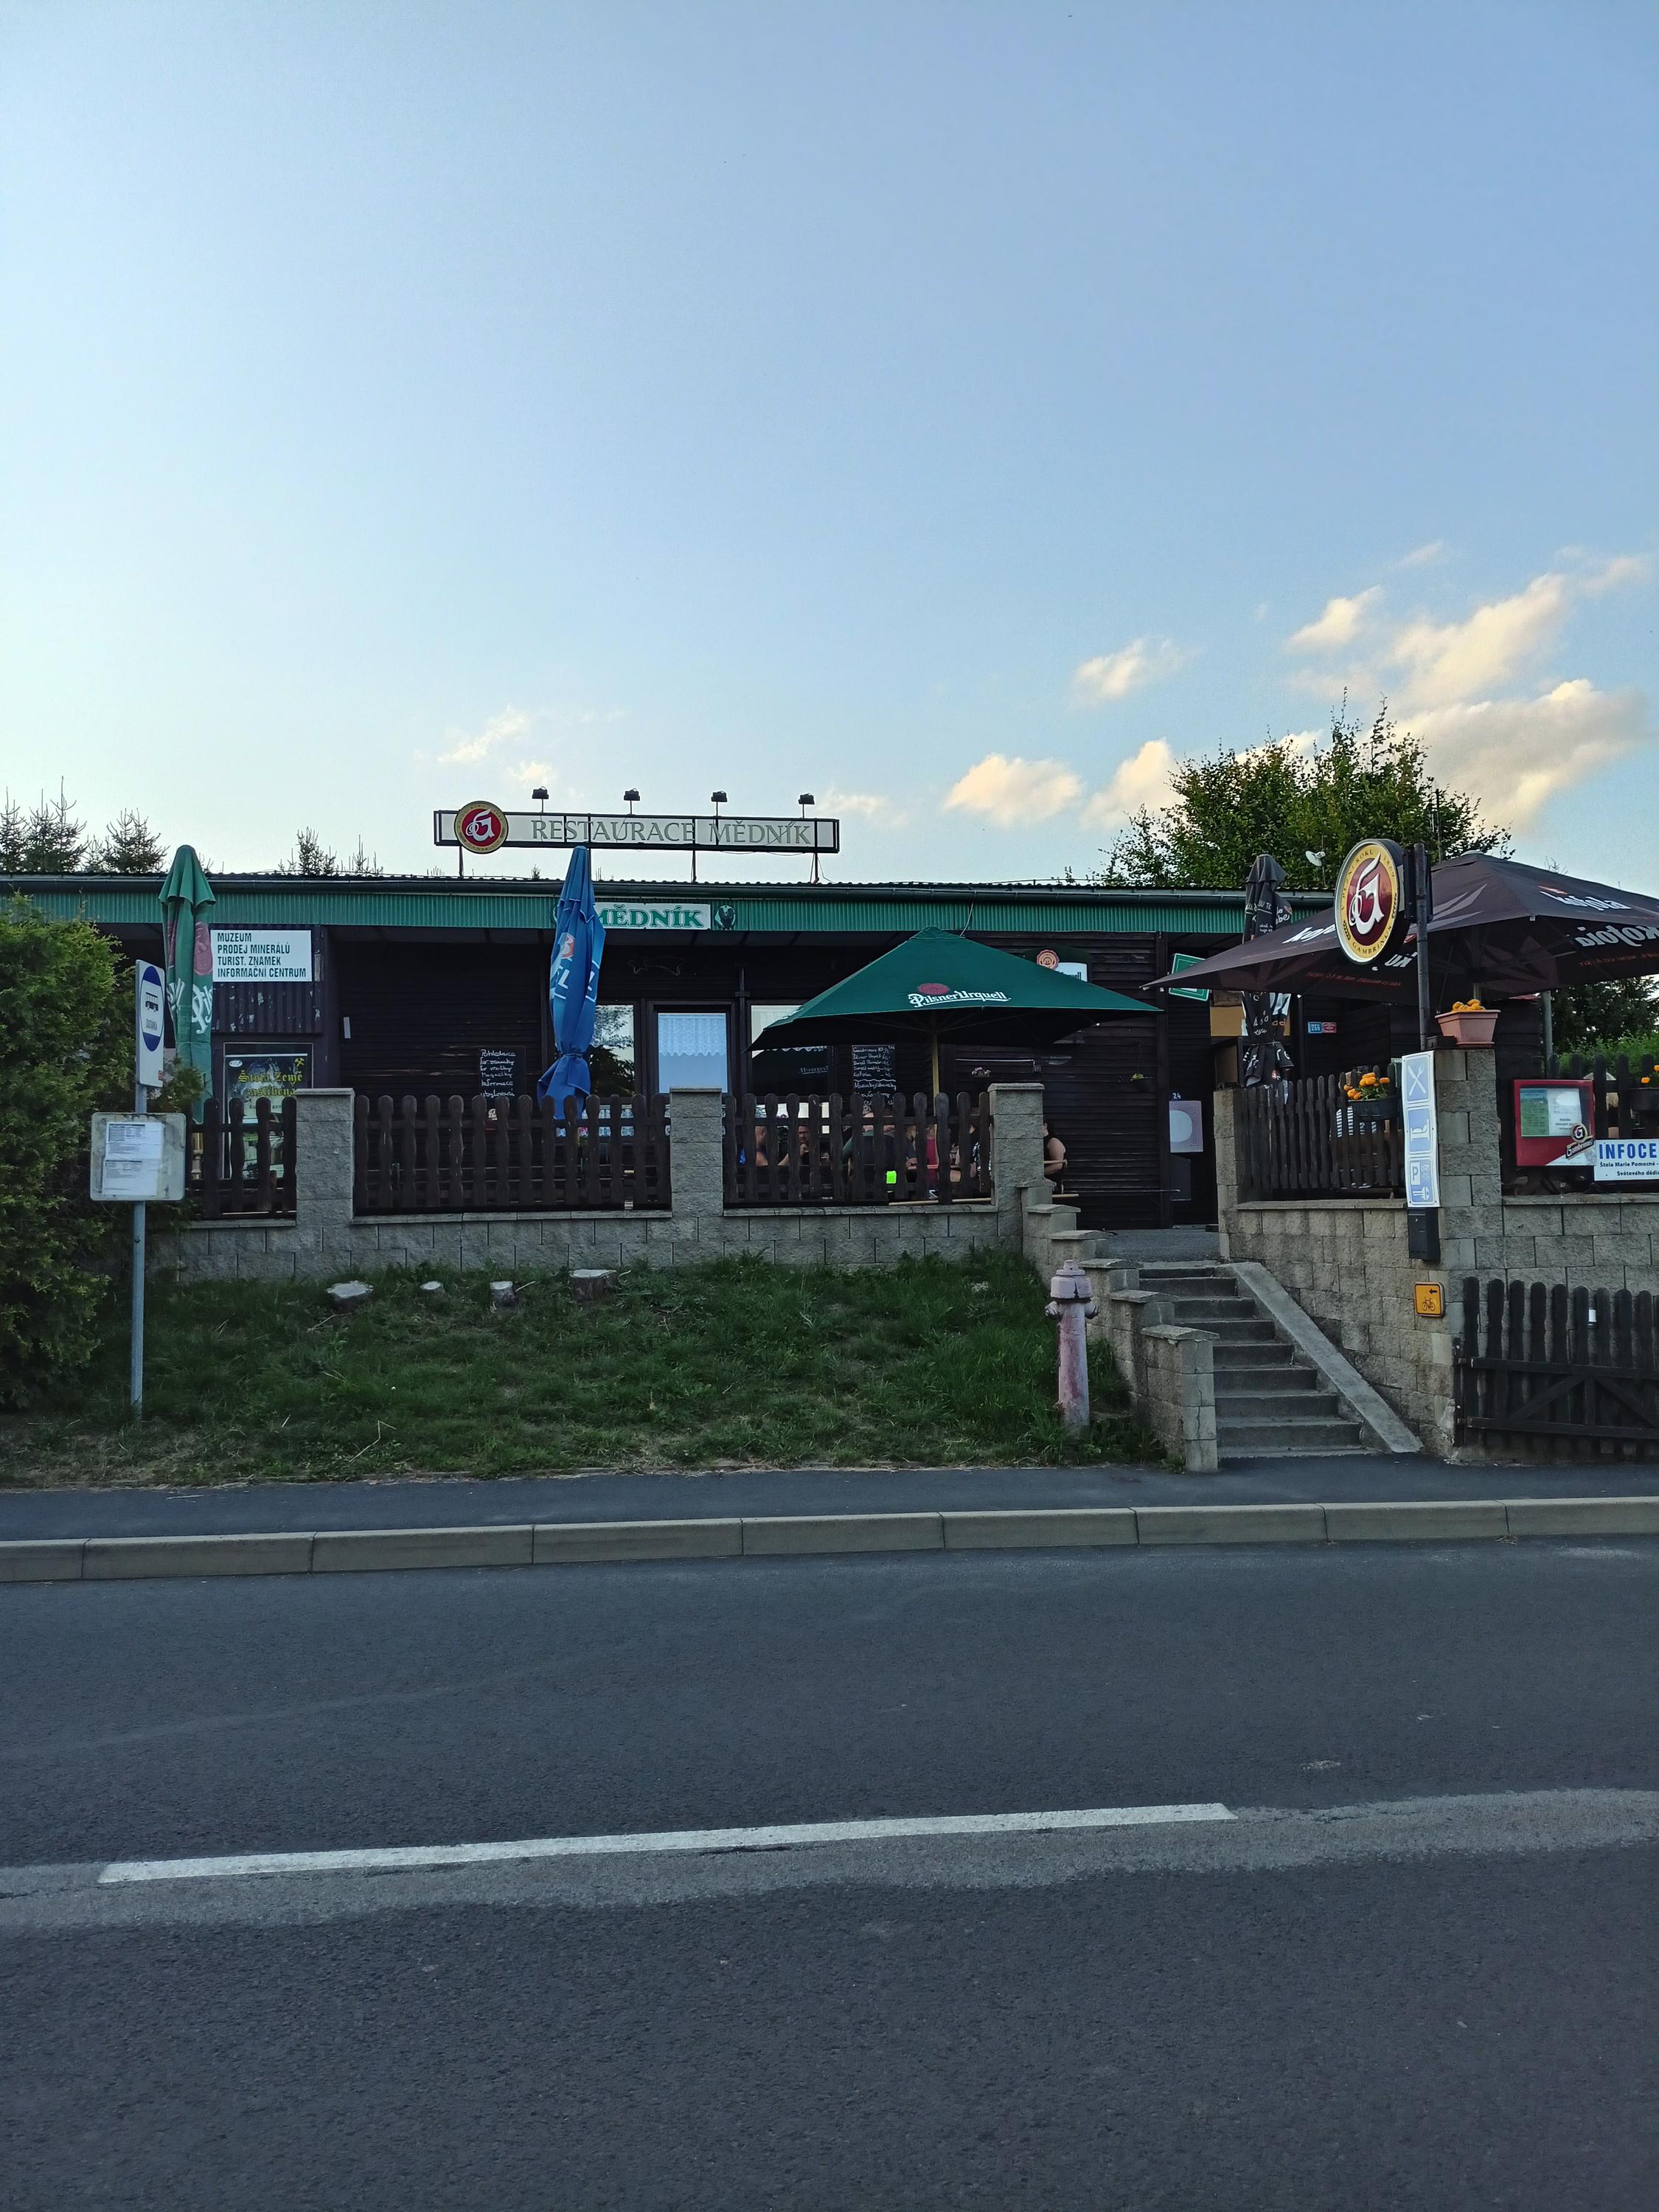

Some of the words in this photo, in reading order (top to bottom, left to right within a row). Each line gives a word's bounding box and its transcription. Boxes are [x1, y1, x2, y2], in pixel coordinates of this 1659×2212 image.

[531, 819, 695, 841] RESTAURACE
[709, 820, 811, 844] MĚDNÍK
[217, 933, 252, 942] MUZEUM
[1352, 925, 1392, 955] GAMBRINUS
[218, 945, 248, 954] PRODEJ
[250, 942, 291, 954] MINERÁLŮ
[218, 956, 246, 966] TURIST.
[248, 956, 282, 966] ZNAMEK
[218, 966, 267, 978] INFORMAČNÍ
[269, 968, 307, 978] CENTRUM
[908, 992, 958, 1008] Pilsner
[954, 990, 1007, 1002] Urquell
[1311, 1023, 1321, 1032] 266
[274, 1071, 303, 1082] Země
